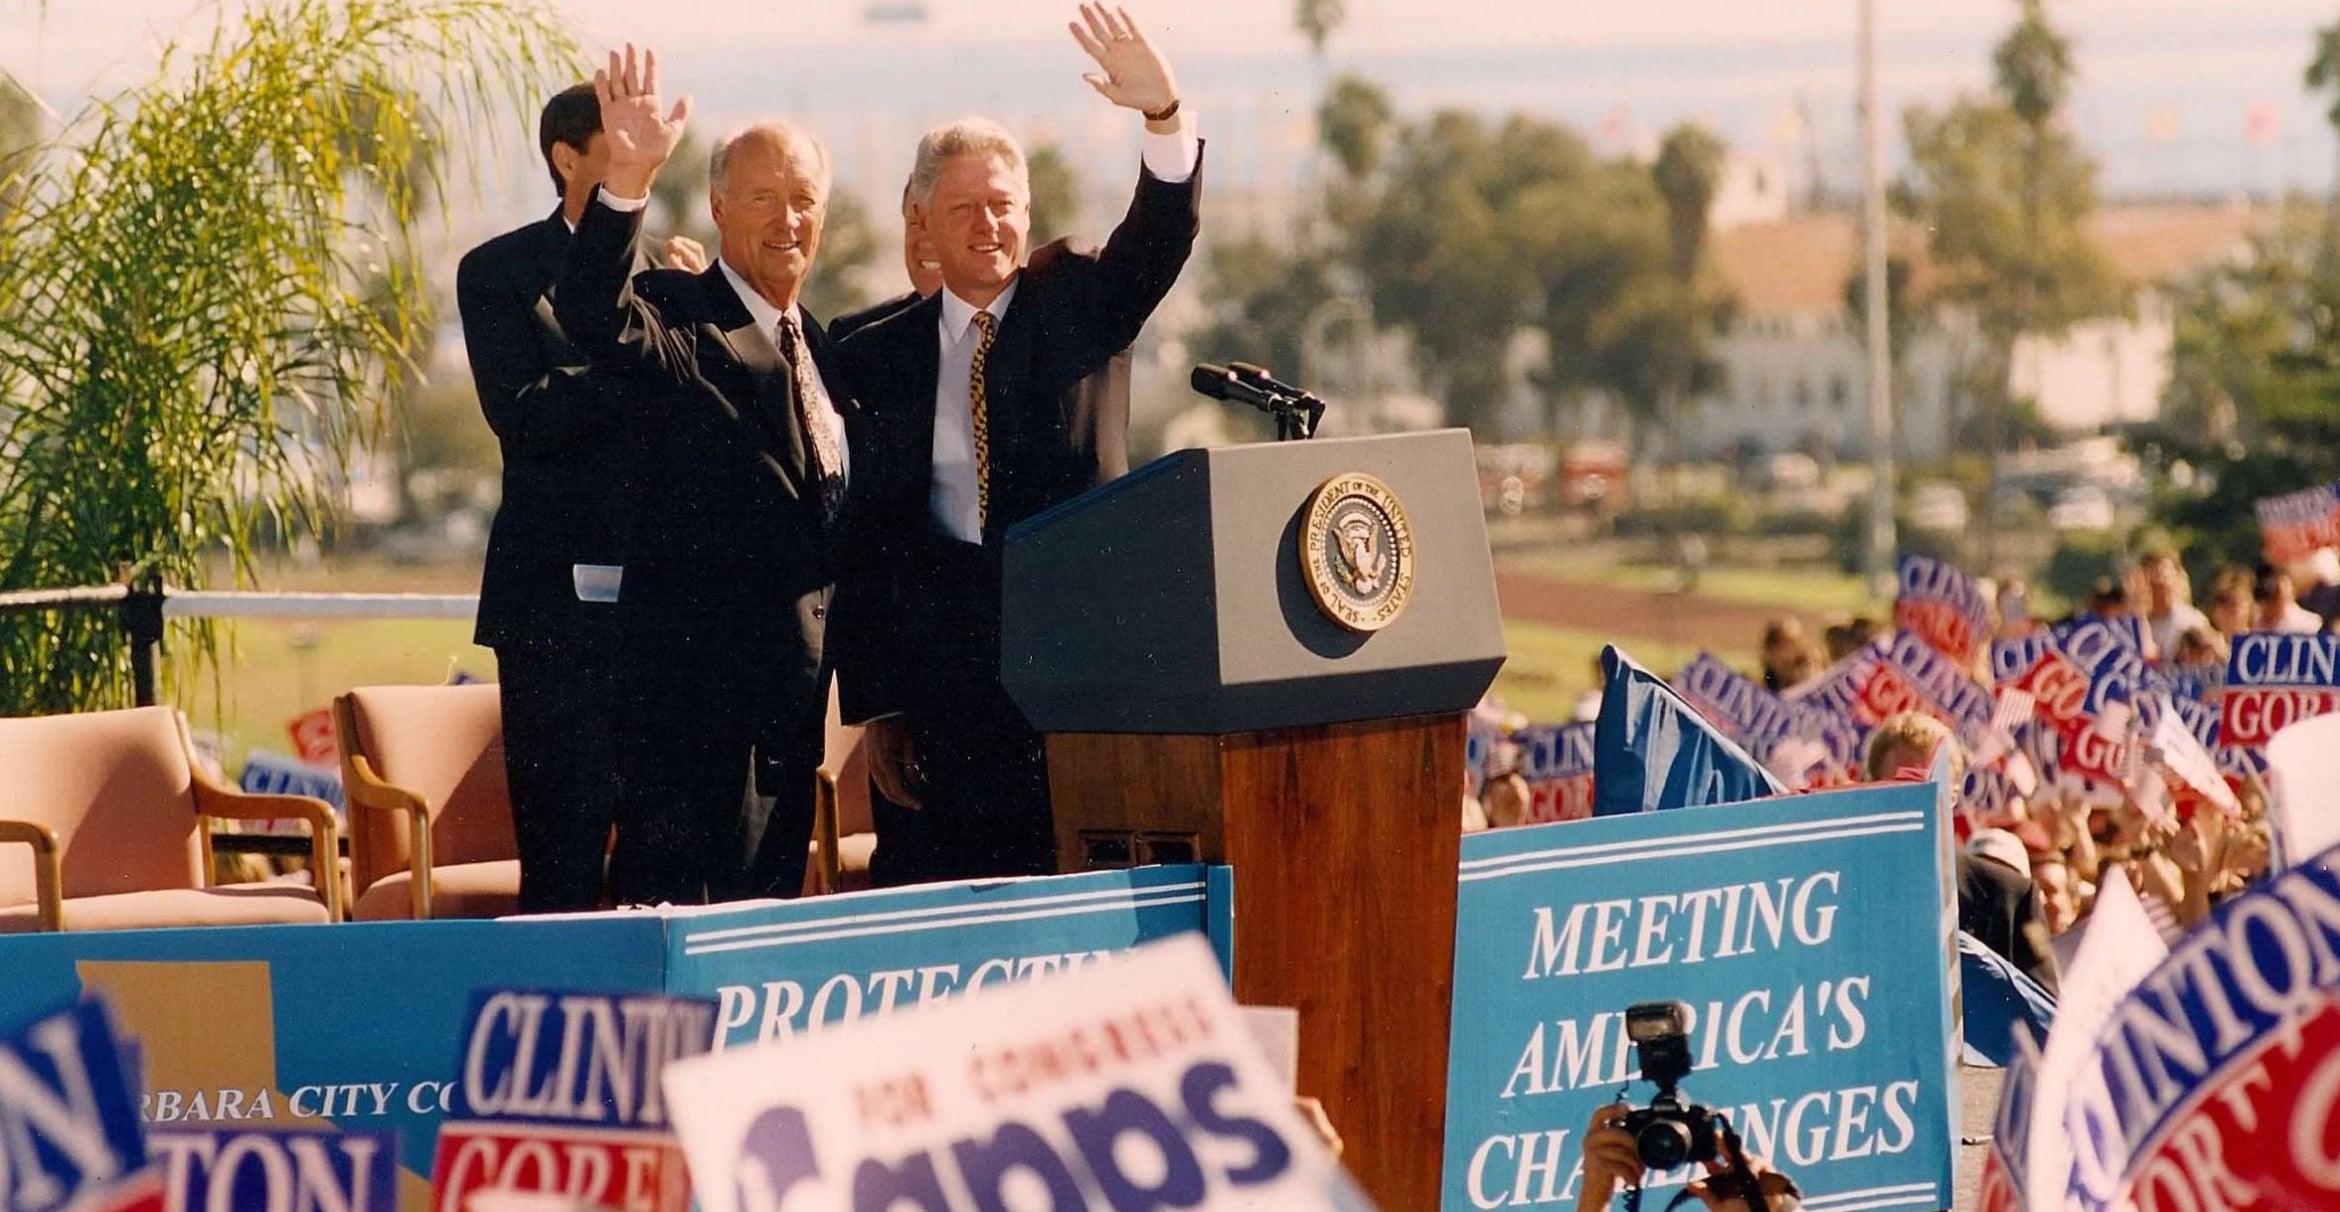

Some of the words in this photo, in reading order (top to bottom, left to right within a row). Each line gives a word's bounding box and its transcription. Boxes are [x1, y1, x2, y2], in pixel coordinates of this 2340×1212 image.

[1310, 480, 1350, 551] PRESIDENT
[1365, 483, 1380, 499] THE
[1382, 494, 1412, 559] UNITED
[1312, 558, 1324, 580] THE
[1319, 581, 1331, 595] OF
[1331, 594, 1360, 623] SEAL
[1377, 572, 1410, 618] STATES
[2237, 635, 2340, 685] CLIN
[1523, 871, 1841, 980] MEETING
[712, 948, 1132, 1053] PROTEC
[464, 992, 712, 1124] CLINT
[289, 1082, 398, 1118] CITY
[1467, 1080, 1919, 1211] CHNGES
